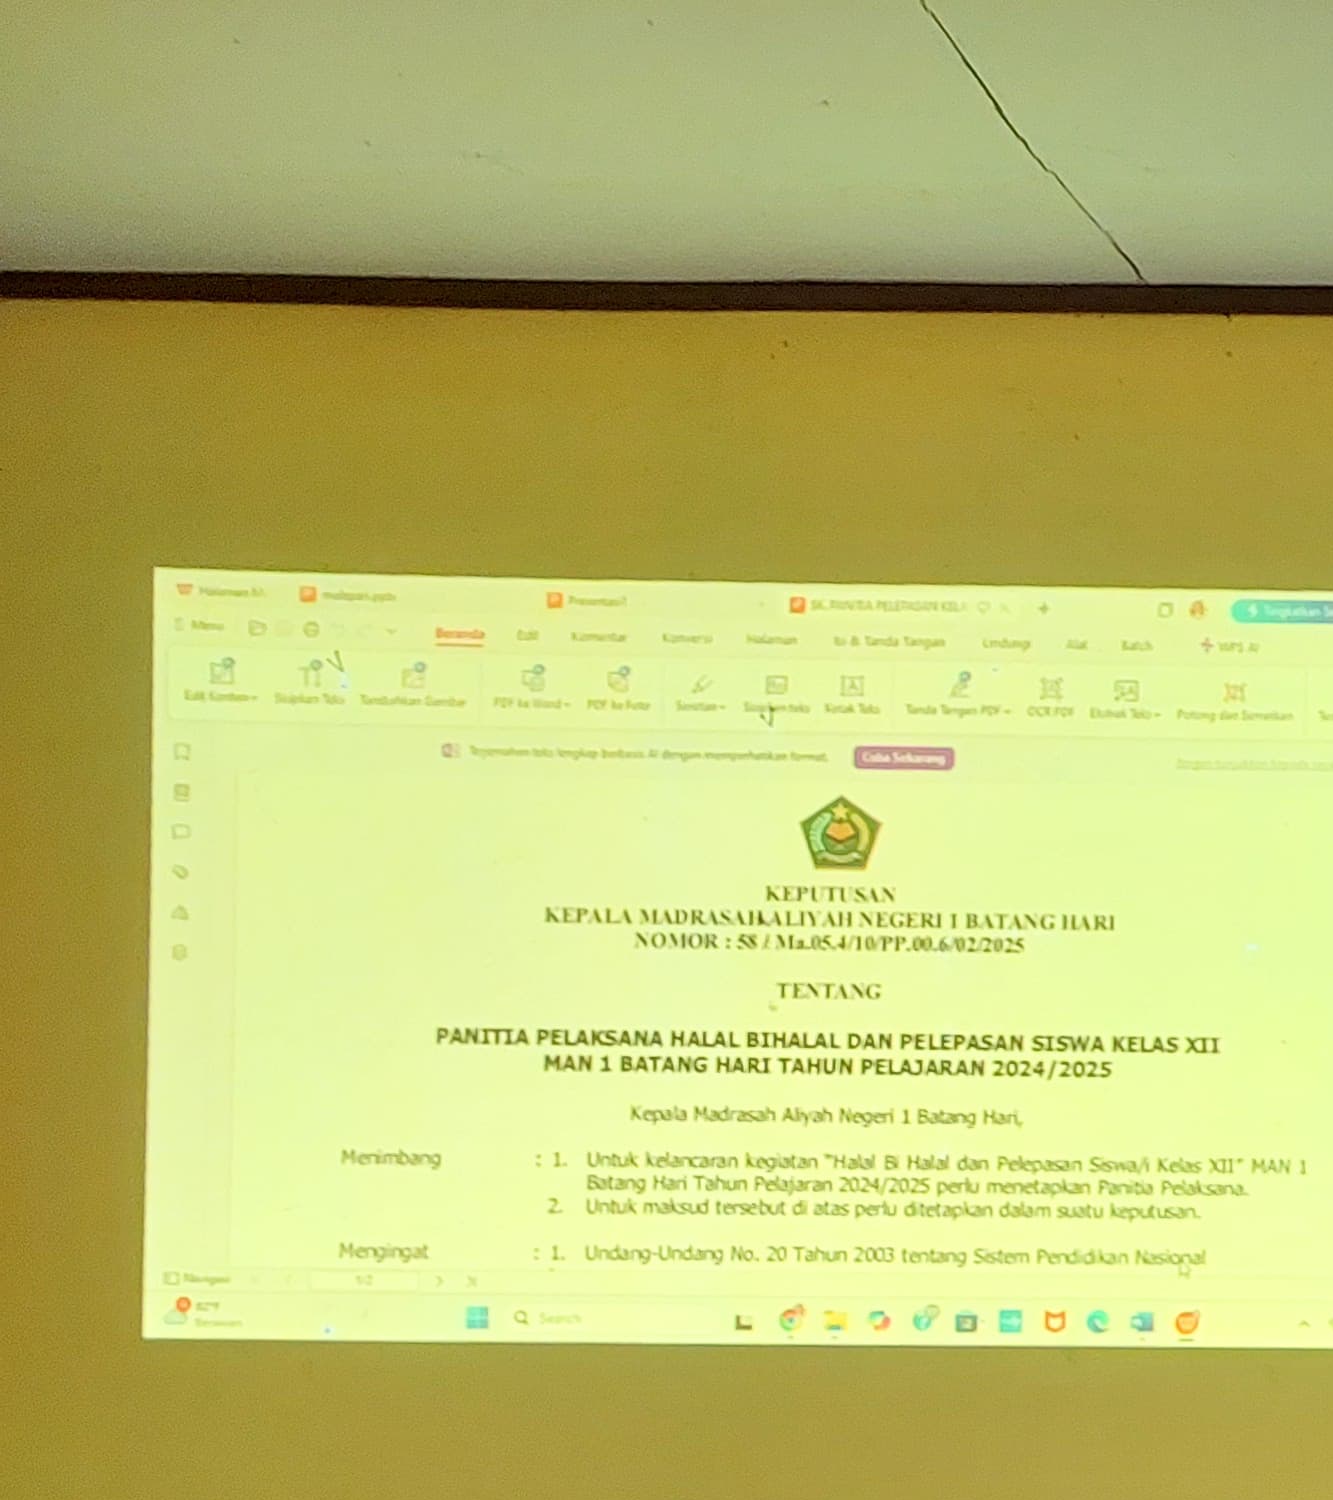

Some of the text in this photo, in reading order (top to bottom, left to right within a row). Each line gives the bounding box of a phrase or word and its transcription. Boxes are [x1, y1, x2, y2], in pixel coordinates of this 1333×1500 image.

[766, 885, 896, 902] KEPUTUSAN
[545, 906, 632, 924] KEPALA
[859, 911, 942, 929] NEGERI
[950, 912, 957, 929] 1
[965, 913, 1055, 930] BATANG
[1061, 914, 1116, 931] HARI
[634, 932, 719, 949] NOMOR
[736, 933, 757, 950] 58
[777, 983, 882, 1000] TENTANG
[437, 1028, 1221, 1054] PANITIA PELAKSANA HALAL BIHALAL DAN PELEPASAN SISWA KELAS XII
[544, 1055, 1112, 1080] MAN 1 BATANG HARI TAHUN PELAJARAN 2024/2025
[630, 1106, 1023, 1128] Kepala Madrasah Aliyah Negeri 1 Batang Hari,
[341, 1148, 442, 1170] Menimbang
[552, 1152, 567, 1168] 1.
[587, 1151, 638, 1168] Untuk
[646, 1152, 738, 1170] kelancaran
[745, 1152, 818, 1172] kegiatan
[824, 1153, 876, 1170] "Halal
[884, 1154, 899, 1170] Bi
[907, 1154, 950, 1171] Halal
[958, 1155, 989, 1173] dan
[997, 1156, 1082, 1176] Pelepasan
[1089, 1157, 1150, 1174] Siswa/i
[1158, 1157, 1202, 1174] Kelas
[1252, 1158, 1292, 1175] MAN
[1300, 1160, 1307, 1175] 1
[586, 1175, 1250, 1198] Batang Hari Tahun Pelajaran 2024/2025 perlu menetapkan Panitia Pelaksana.
[547, 1197, 1202, 1222] 2. Untuk maksud tersebut di atas perlu ditetapkan dalam suatu keputusan.
[338, 1242, 430, 1263] Mengingat
[551, 1244, 565, 1261] 1.
[584, 1245, 723, 1265] Undang-Undang
[730, 1245, 760, 1262] No.
[767, 1246, 787, 1262] 20
[792, 1246, 847, 1263] Tahun
[854, 1247, 894, 1264] 2003
[902, 1247, 966, 1267] tentang
[973, 1248, 1029, 1264] Sistem
[1036, 1248, 1128, 1265] Pendidikan
[540, 1312, 583, 1326] Search
